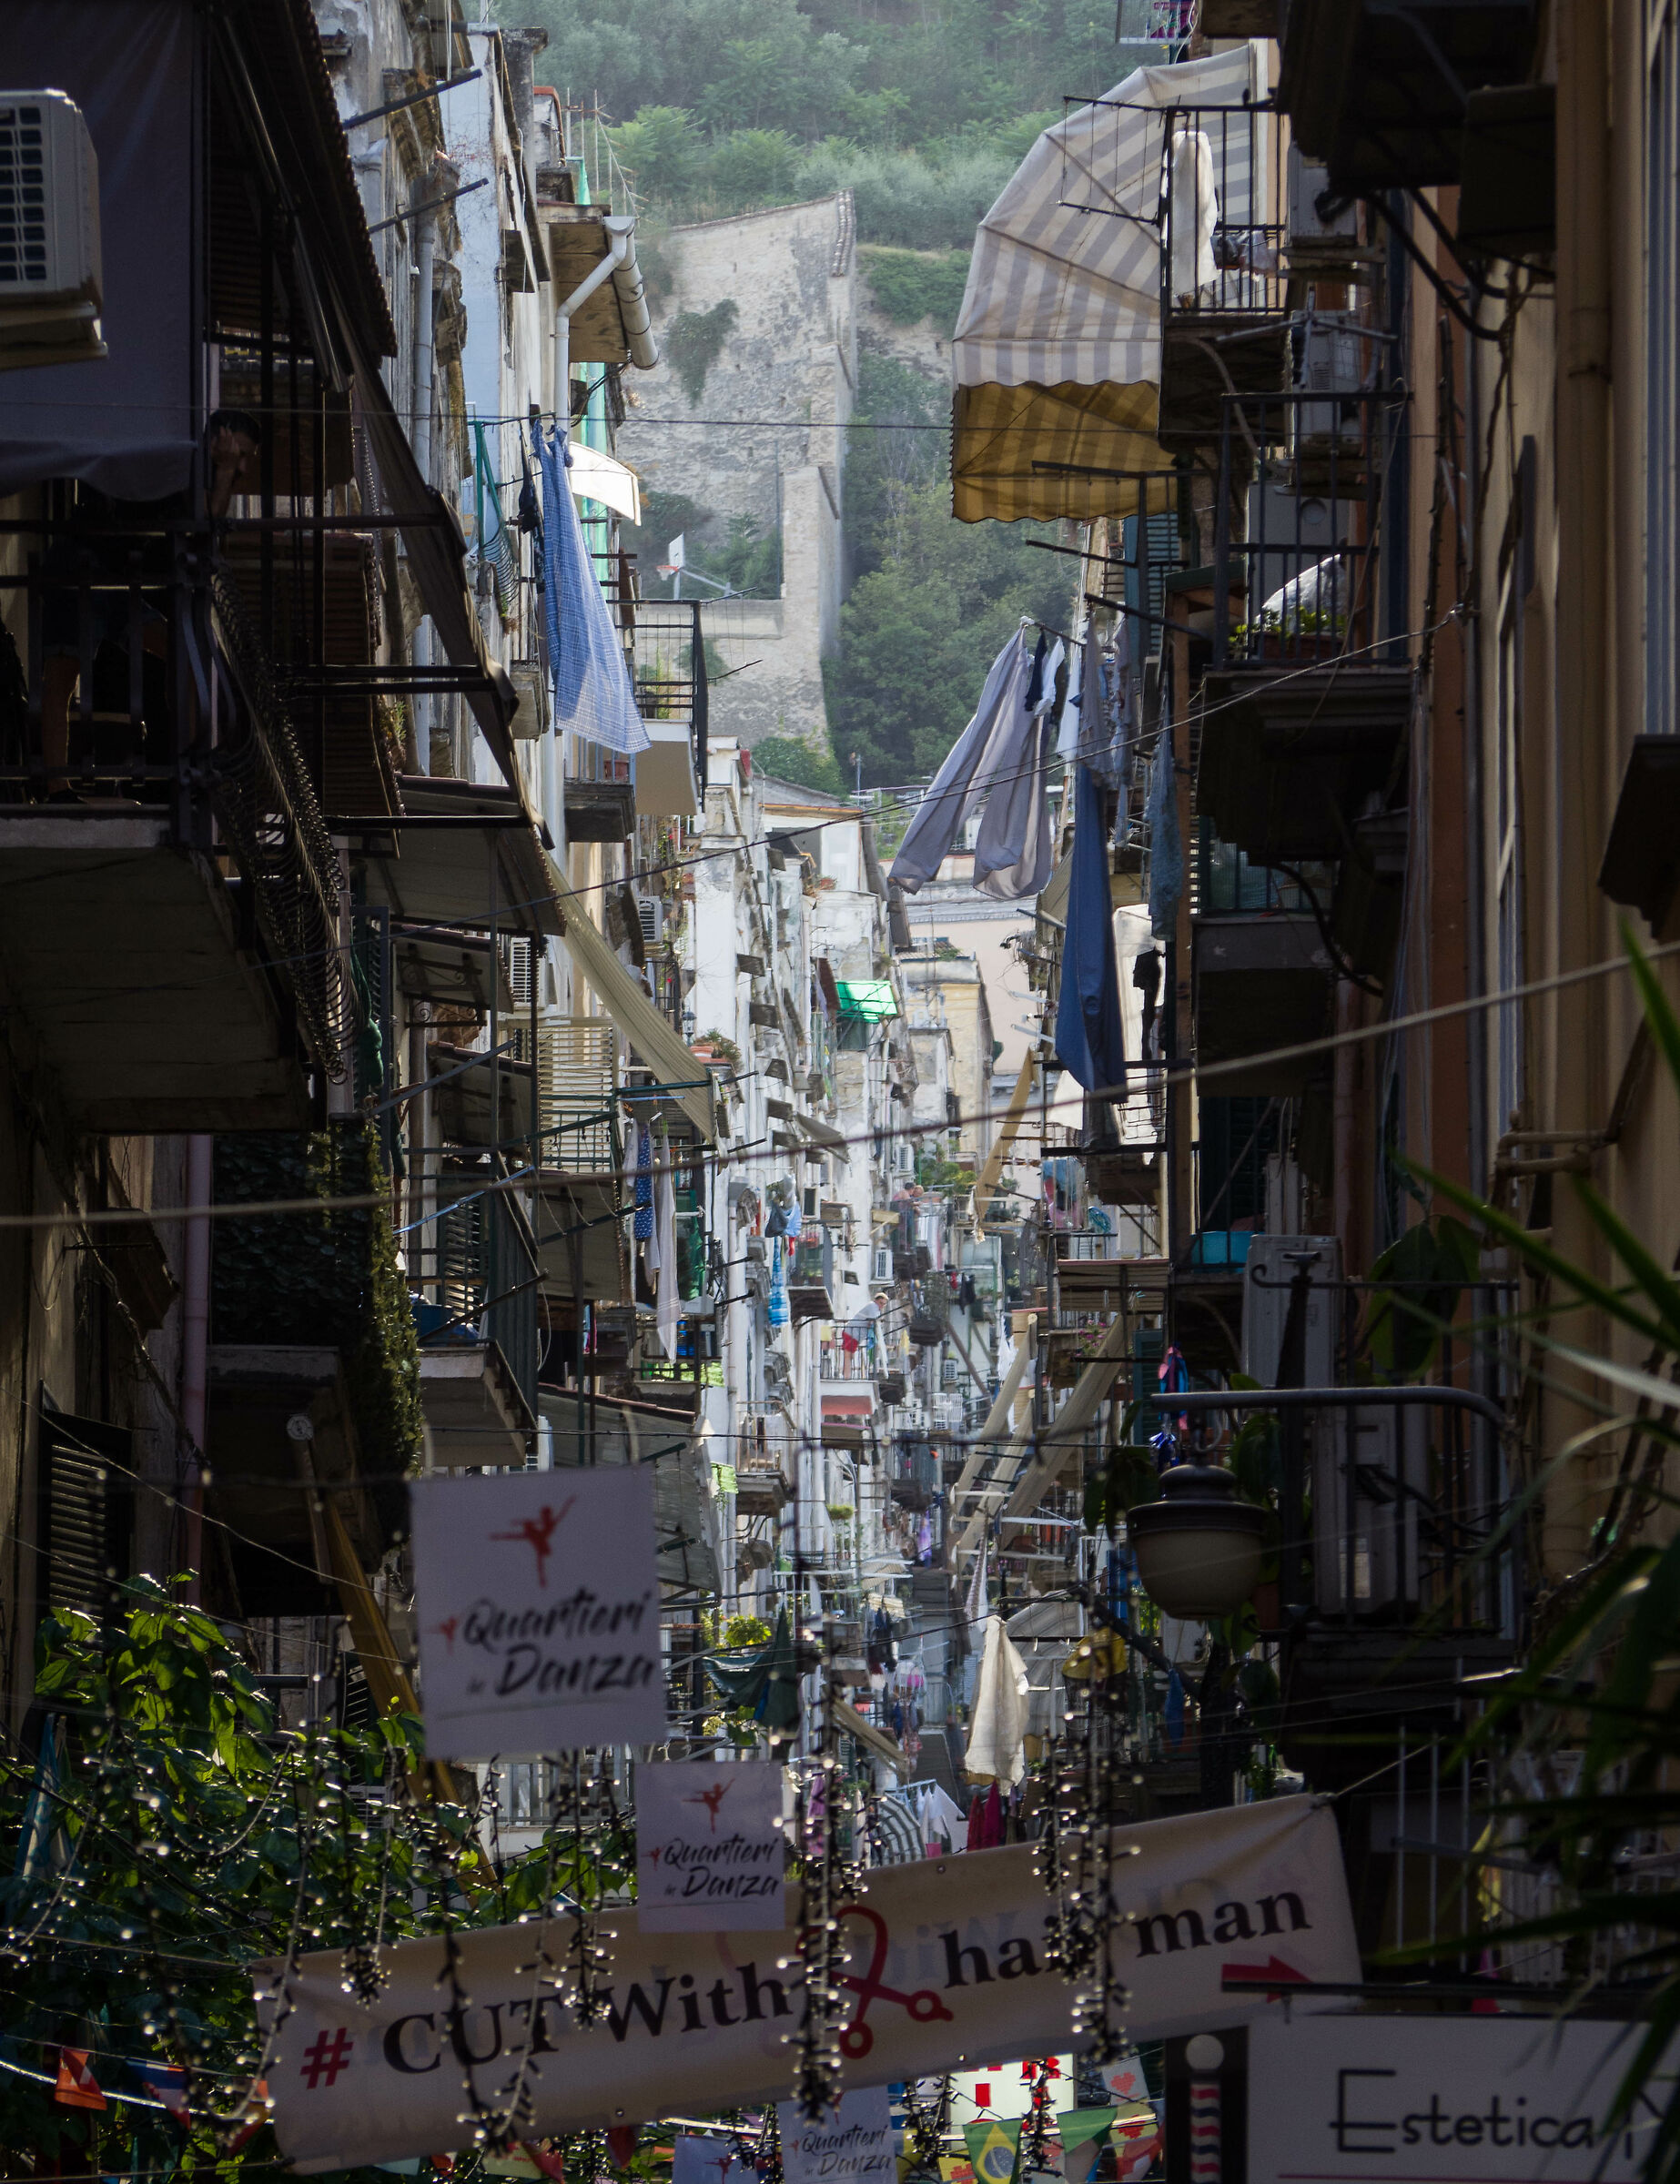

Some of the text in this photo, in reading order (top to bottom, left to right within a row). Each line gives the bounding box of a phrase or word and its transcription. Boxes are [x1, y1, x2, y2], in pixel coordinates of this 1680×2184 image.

[462, 1588, 652, 1654] Quartieri
[496, 1643, 653, 1695] Danza
[664, 1834, 779, 1868] Quartieri
[682, 1866, 779, 1897] Danza
[596, 1962, 794, 2042] With
[1132, 1892, 1313, 1958] man
[1330, 2068, 1594, 2153] Estetica
[802, 2124, 888, 2156] Quartieri
[818, 2151, 891, 2176] Danza
